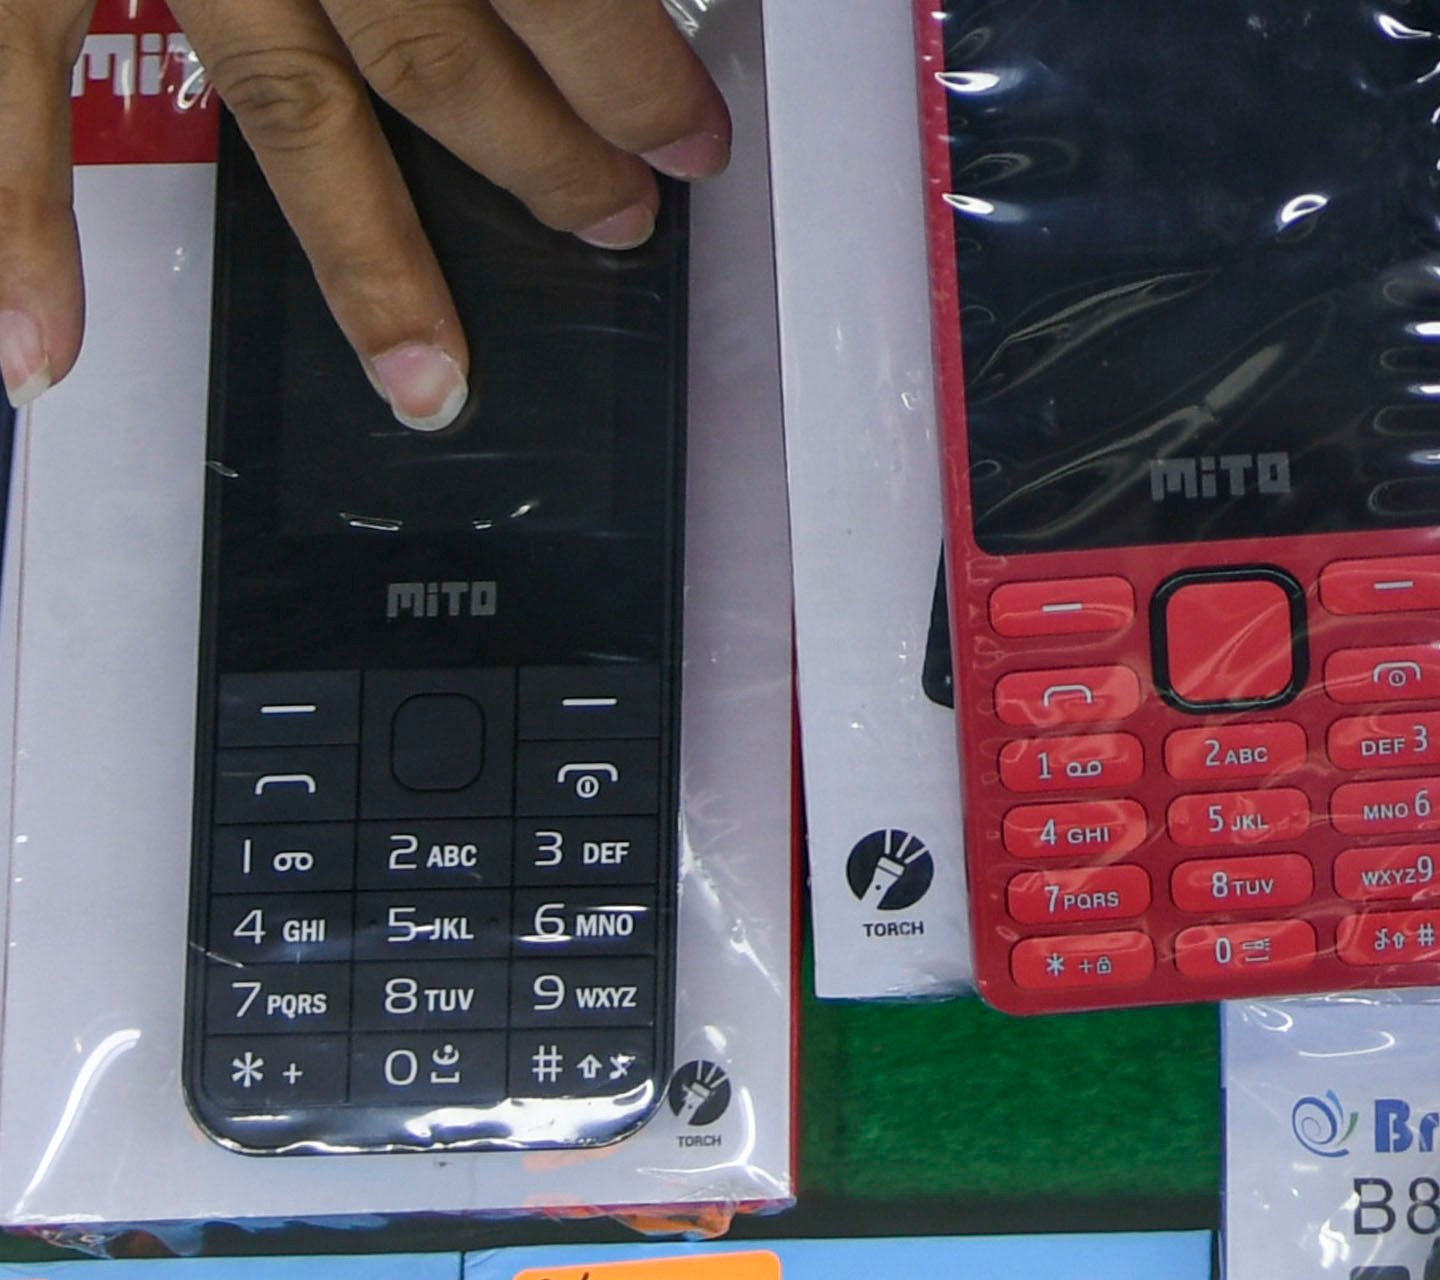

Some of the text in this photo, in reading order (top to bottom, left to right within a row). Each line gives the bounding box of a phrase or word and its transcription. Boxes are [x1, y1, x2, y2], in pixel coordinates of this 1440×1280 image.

[71, 32, 212, 98] MiT
[1224, 747, 1268, 765] ABC
[1361, 737, 1405, 756] DEF
[1231, 814, 1269, 832] JKL
[1363, 803, 1409, 820] MNO
[388, 834, 477, 870] 2 ABC
[534, 831, 629, 866] 3 DEF
[1066, 827, 1110, 845] GHI
[241, 838, 252, 874] 1
[1232, 877, 1274, 896] TUV
[1361, 868, 1416, 887] WXYZ
[1063, 890, 1119, 912] PQRS
[233, 908, 325, 944] 4 GHI
[387, 906, 474, 942] 5 JKL
[533, 903, 634, 938] 6 MNO
[863, 921, 924, 937] TORCH
[232, 981, 327, 1019] 7 PQRS
[384, 977, 474, 1014] 8 TUV
[533, 974, 637, 1011] 9 WXYZ
[384, 1049, 418, 1086] 0
[678, 1135, 722, 1148] TORCH
